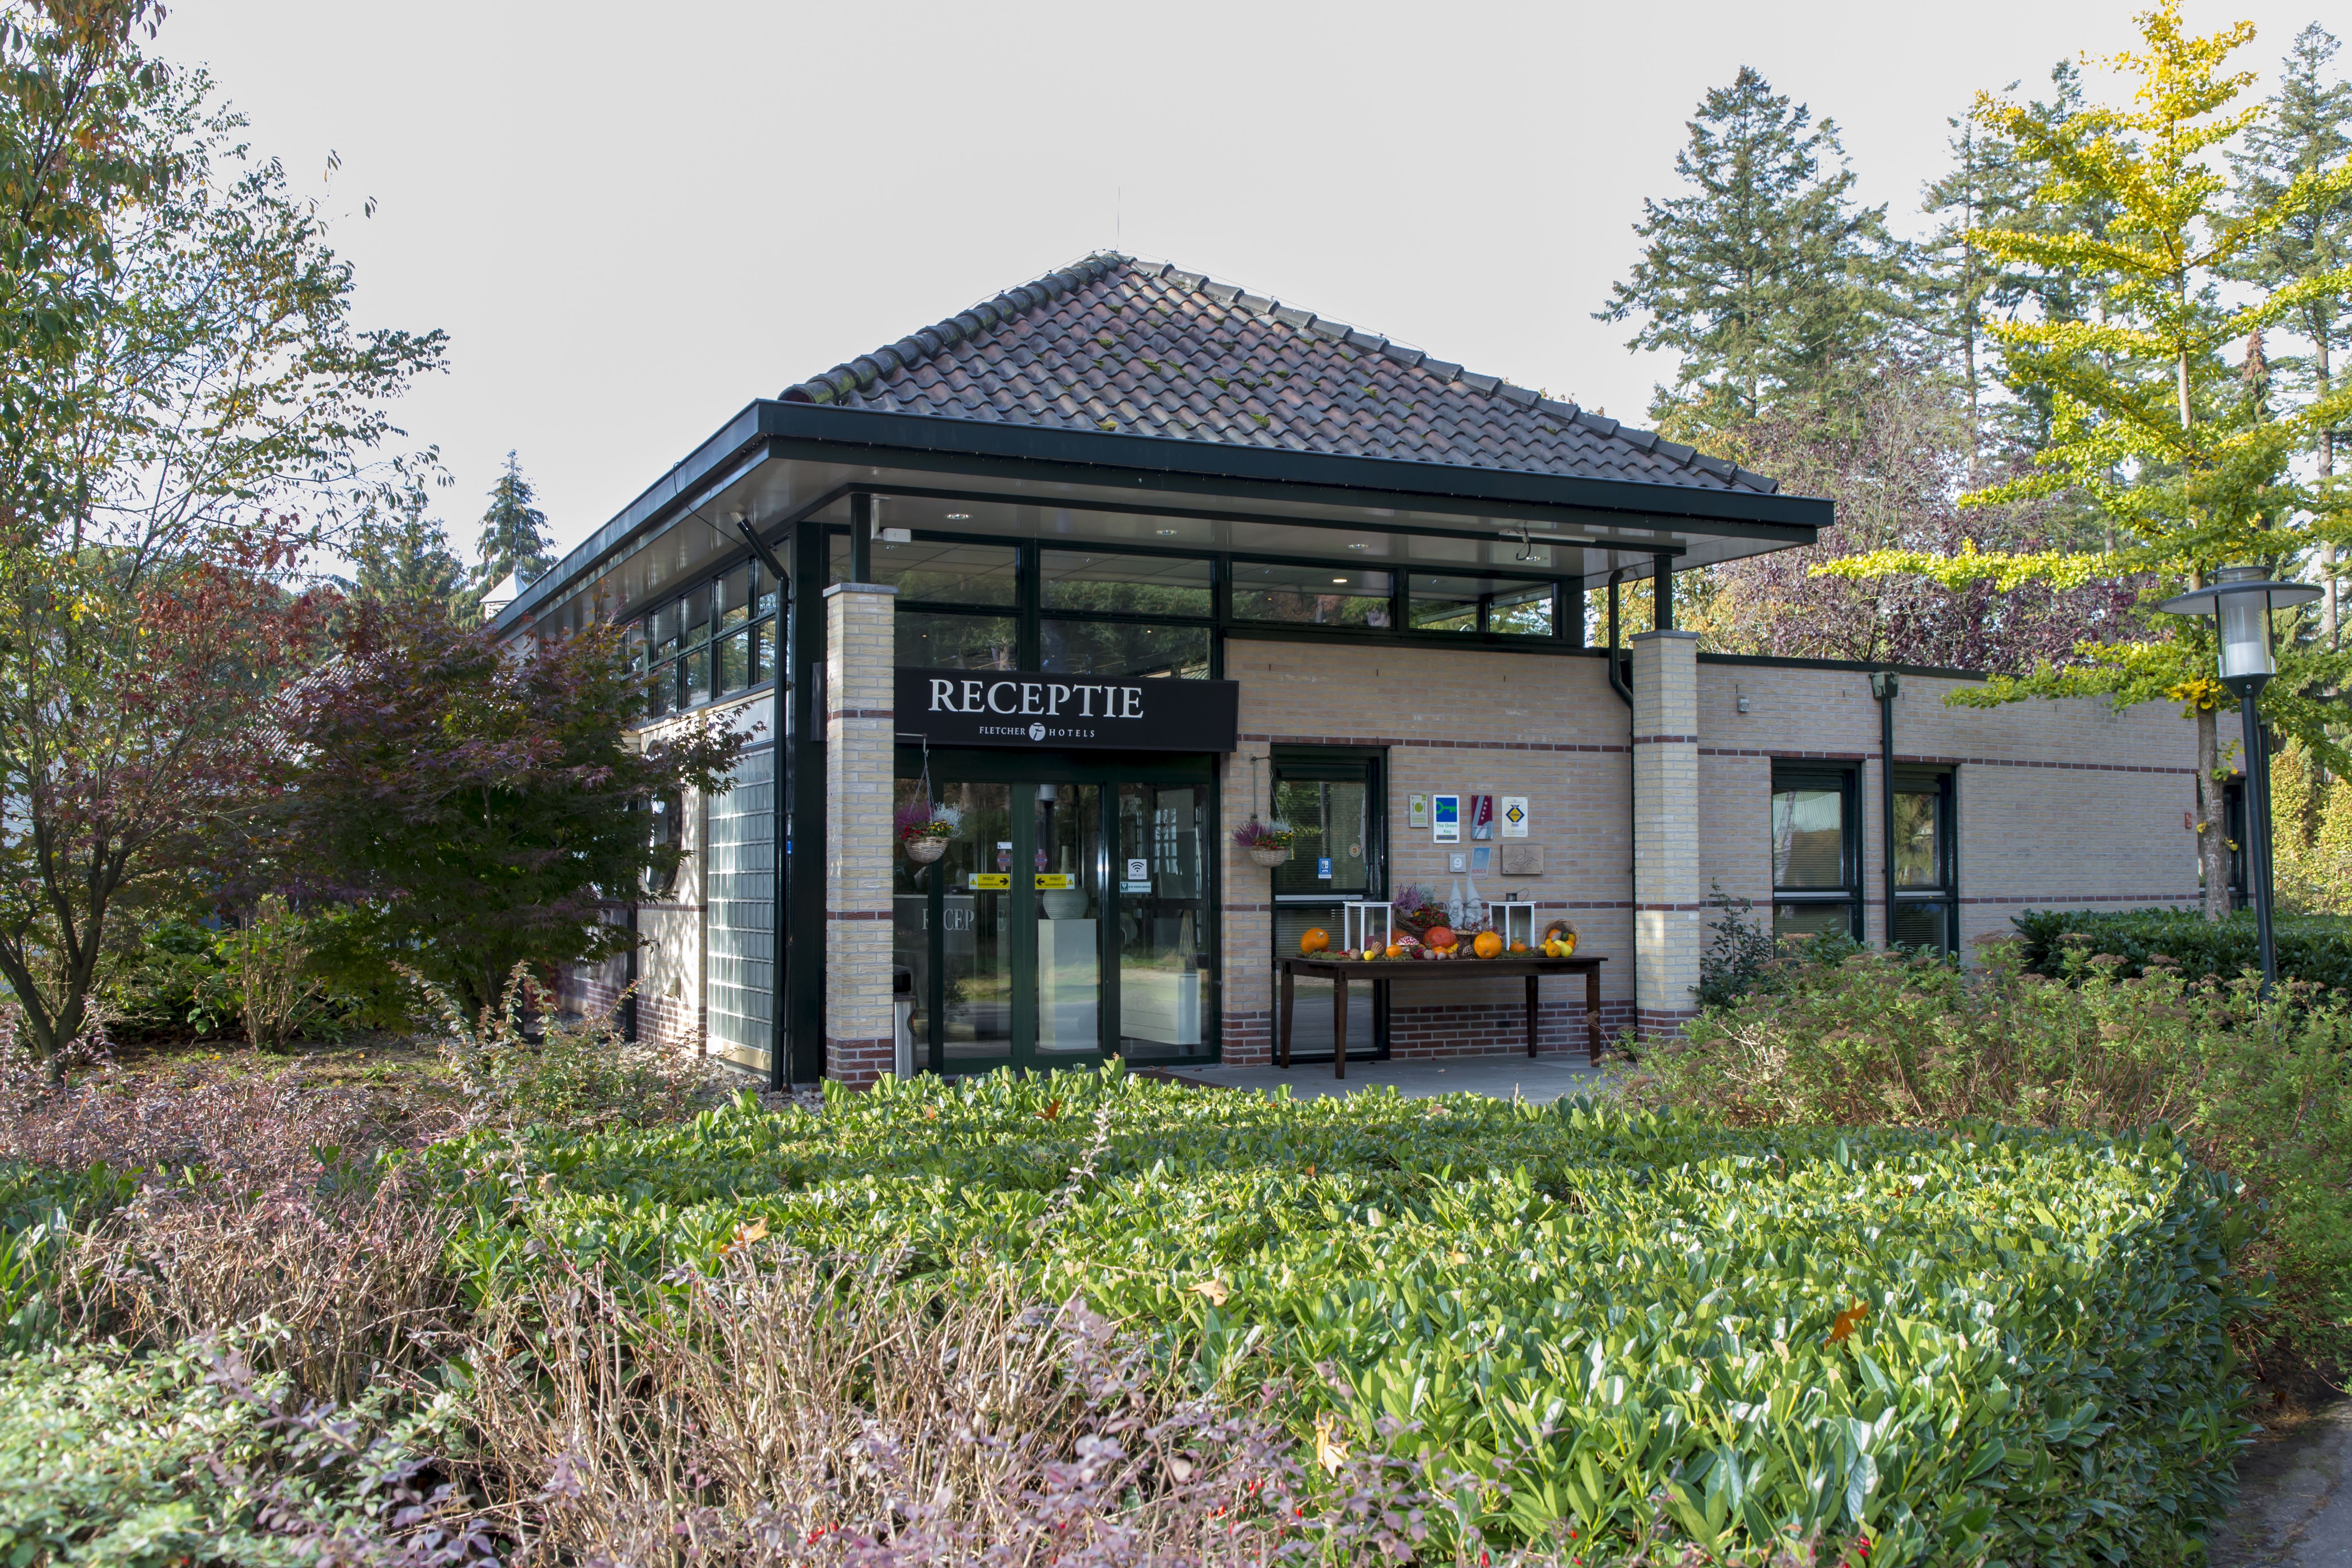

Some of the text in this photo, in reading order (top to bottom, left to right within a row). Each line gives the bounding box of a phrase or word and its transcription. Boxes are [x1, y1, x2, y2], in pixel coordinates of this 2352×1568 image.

[928, 679, 1144, 718] RECEPTIE
[979, 726, 1026, 735] FLETCHER
[1049, 729, 1095, 737] HOTELS
